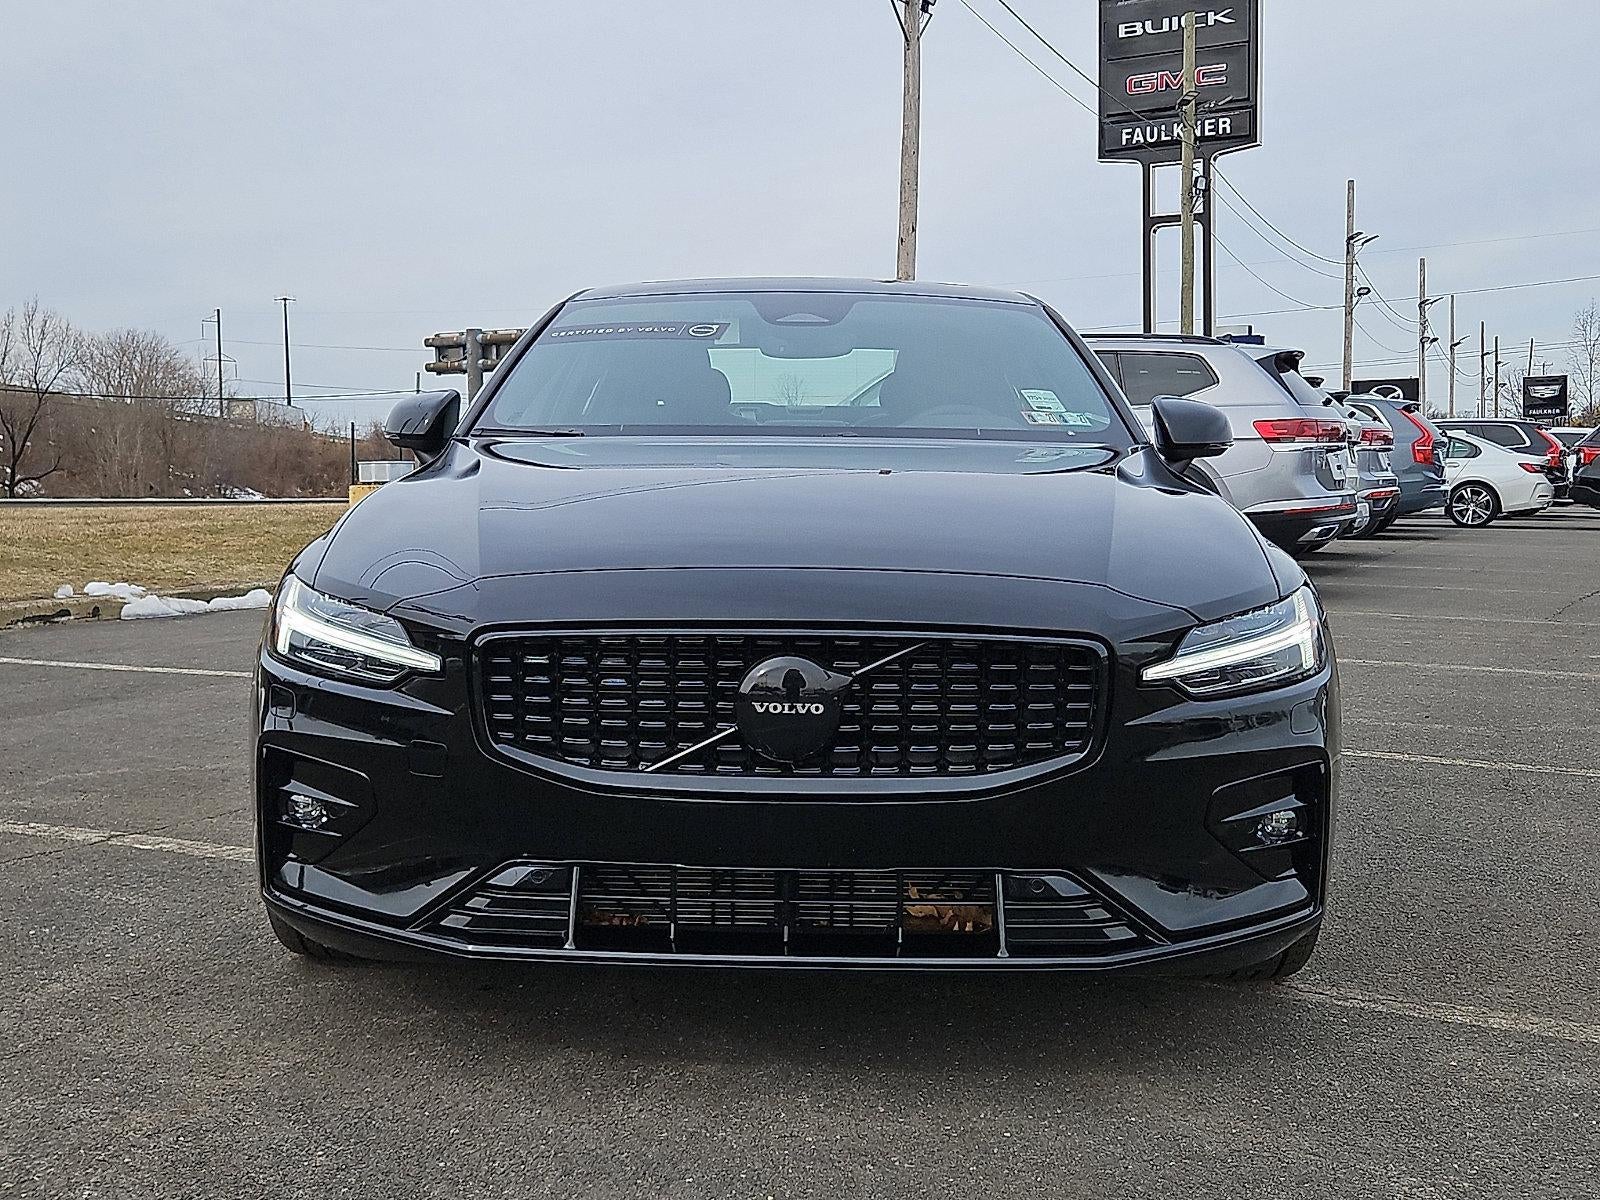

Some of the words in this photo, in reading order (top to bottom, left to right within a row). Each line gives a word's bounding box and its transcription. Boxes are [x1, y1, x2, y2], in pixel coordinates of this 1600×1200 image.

[1118, 8, 1236, 38] BUICK
[1126, 63, 1228, 95] GMC
[551, 327, 614, 337] CERTIFIED
[751, 701, 825, 715] VOLVO
